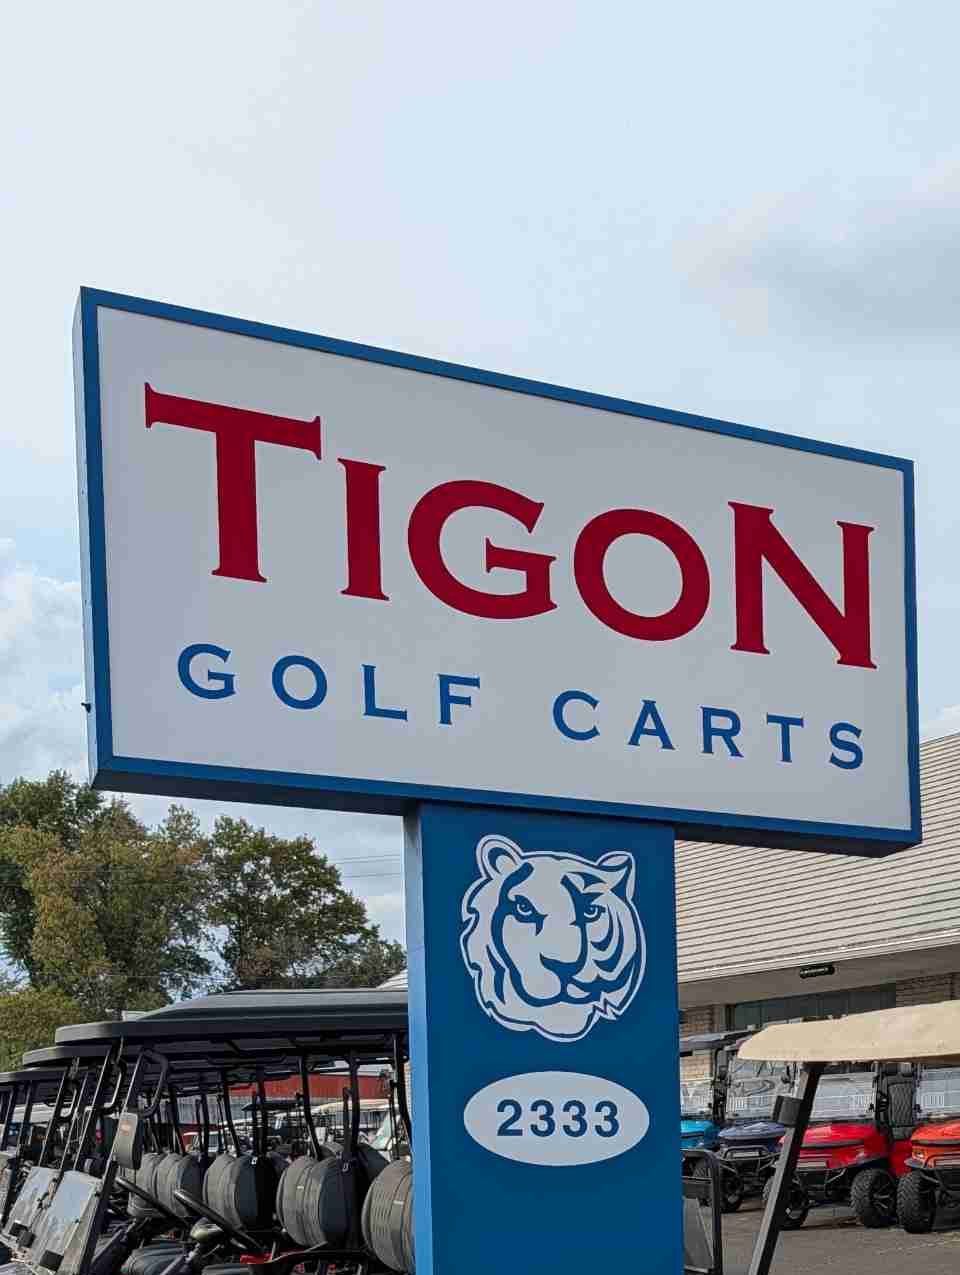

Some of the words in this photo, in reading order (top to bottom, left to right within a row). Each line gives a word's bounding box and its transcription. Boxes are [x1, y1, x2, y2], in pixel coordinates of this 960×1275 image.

[144, 382, 877, 669] TIGON
[177, 643, 480, 726] GOLF
[552, 689, 864, 770] CARTS
[497, 1099, 620, 1138] 2333
